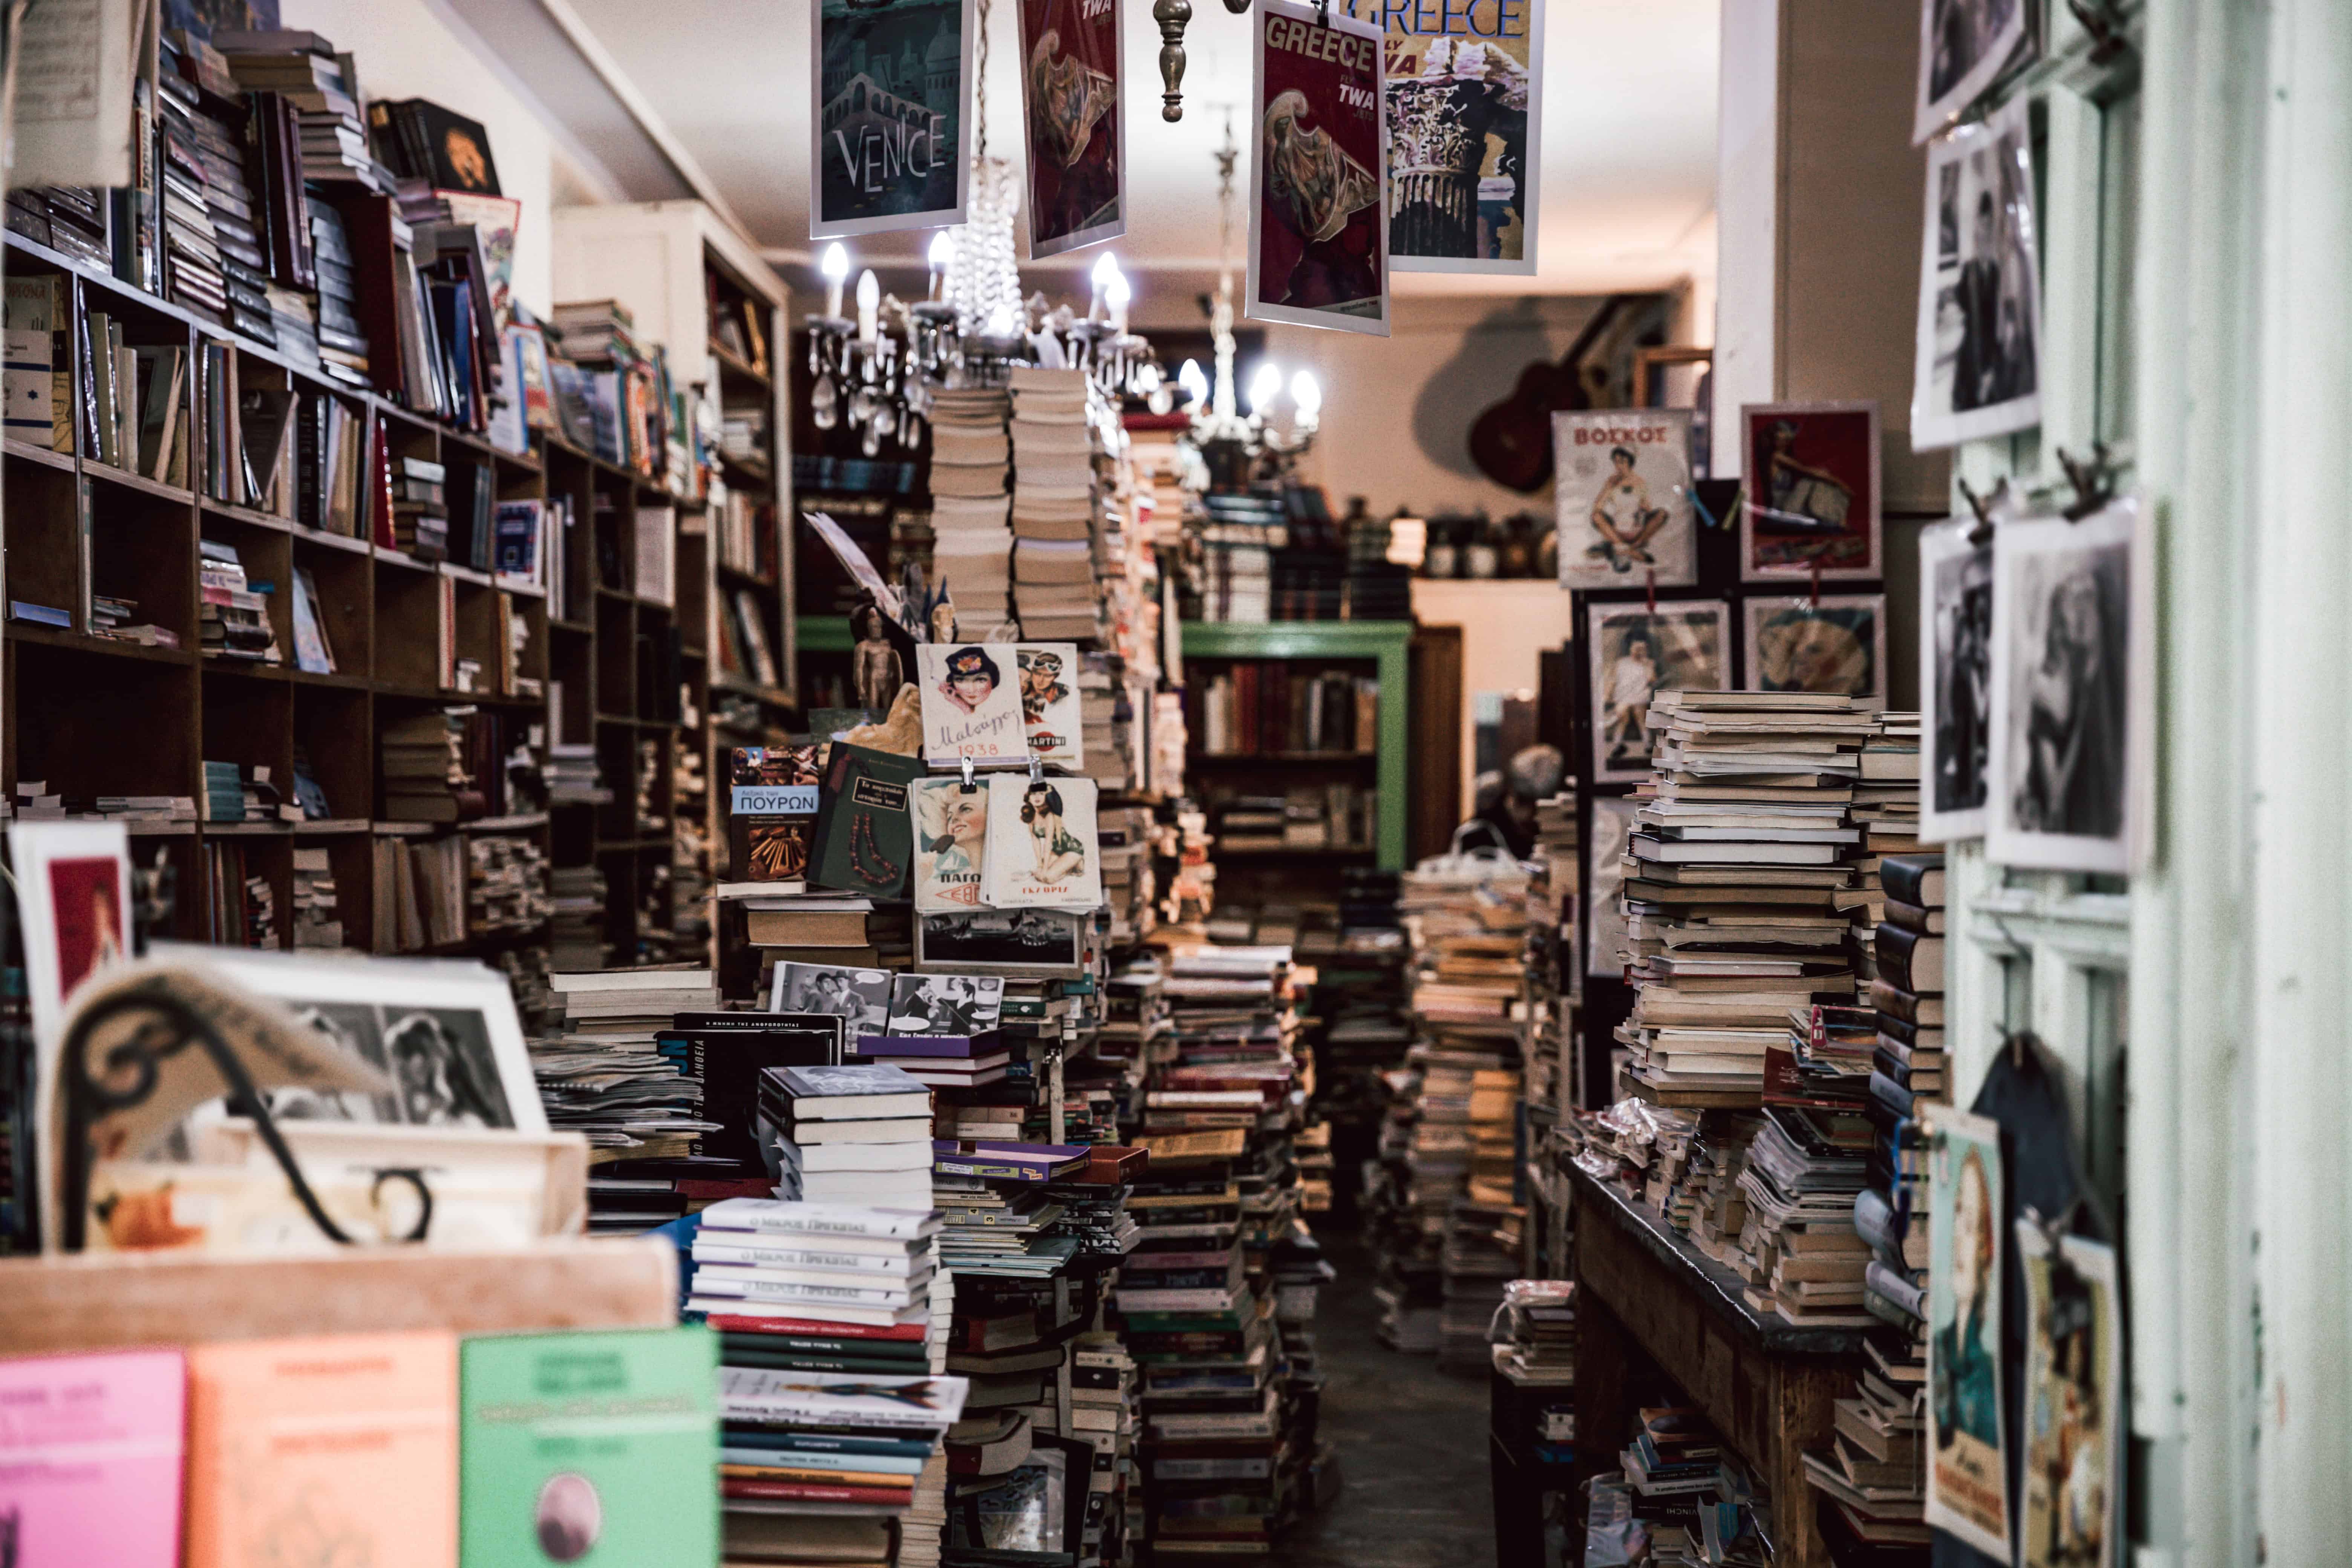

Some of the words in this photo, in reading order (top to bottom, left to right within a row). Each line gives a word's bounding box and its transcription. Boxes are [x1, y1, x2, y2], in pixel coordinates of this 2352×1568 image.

[1083, 0, 1111, 20] TWA
[1266, 17, 1375, 72] GREECE
[1384, 41, 1402, 50] LY
[1339, 84, 1374, 110] TWA
[1354, 109, 1375, 121] JETS
[832, 115, 947, 193] VENICE
[959, 744, 999, 756] 1938
[741, 796, 814, 810] ΠΟΥΡΩΝ
[940, 873, 981, 883] ΠΑΓΩ
[695, 1040, 704, 1080] ΛΗΘΕΙΑ
